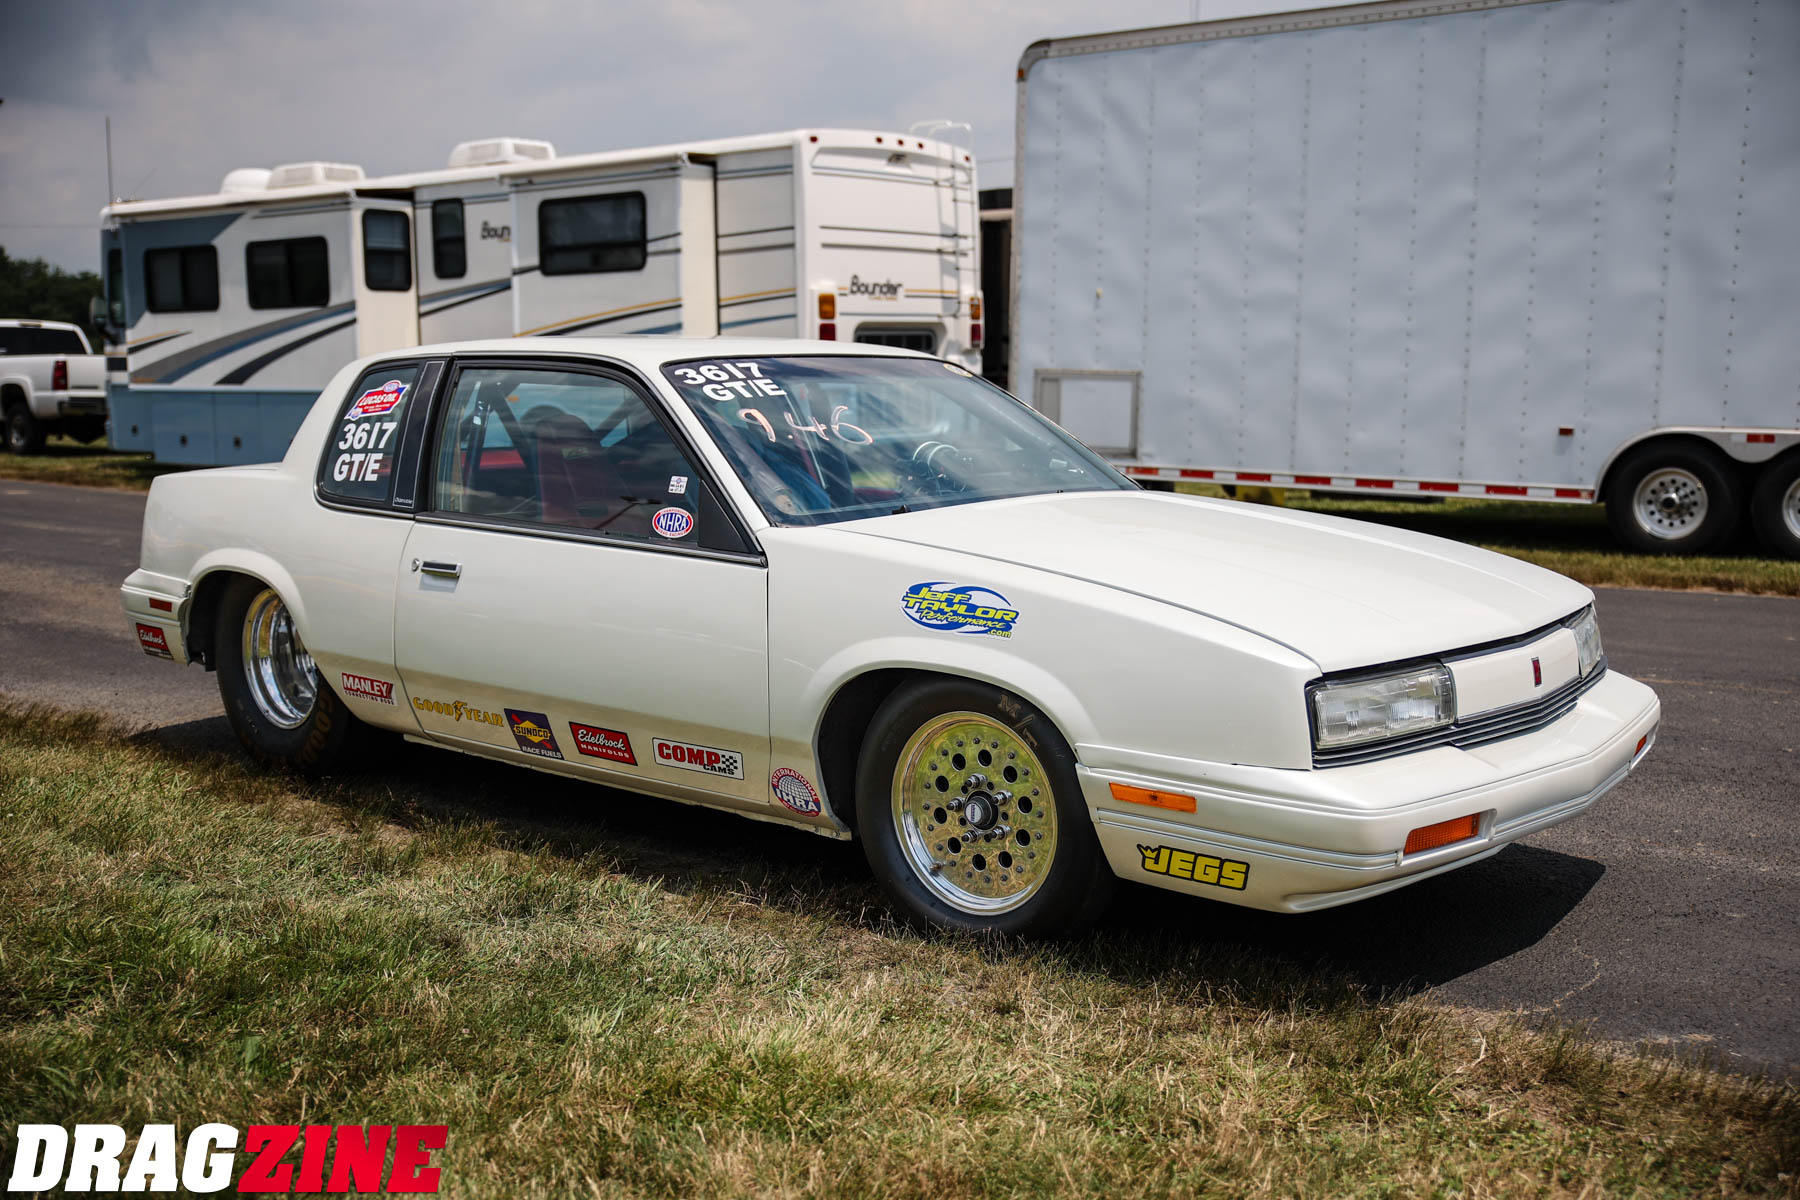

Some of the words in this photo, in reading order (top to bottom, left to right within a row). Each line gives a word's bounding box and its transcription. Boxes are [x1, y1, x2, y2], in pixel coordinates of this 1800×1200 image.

[850, 274, 902, 295] Bounder
[674, 362, 764, 385] 3617
[702, 378, 787, 401] GT/E
[338, 421, 398, 450] 3617
[737, 405, 873, 445] 9.46
[333, 452, 384, 482] GT/E
[659, 513, 687, 532] NHRA
[903, 597, 1017, 622] TAYLOR
[919, 609, 1007, 628] Performance
[987, 628, 1012, 638] .com
[343, 674, 388, 697] MANLEY
[515, 726, 549, 738] SUNOCO
[578, 729, 626, 750] Edelbrock
[521, 745, 541, 755] RACE
[541, 749, 562, 759] FUELS
[580, 743, 630, 758] MANIFOLDS
[657, 742, 721, 766] COMP
[703, 763, 735, 775] CAMS
[771, 768, 819, 800] INTERNATIONAL
[776, 788, 819, 811] IHRA
[1142, 845, 1250, 890] JEGS
